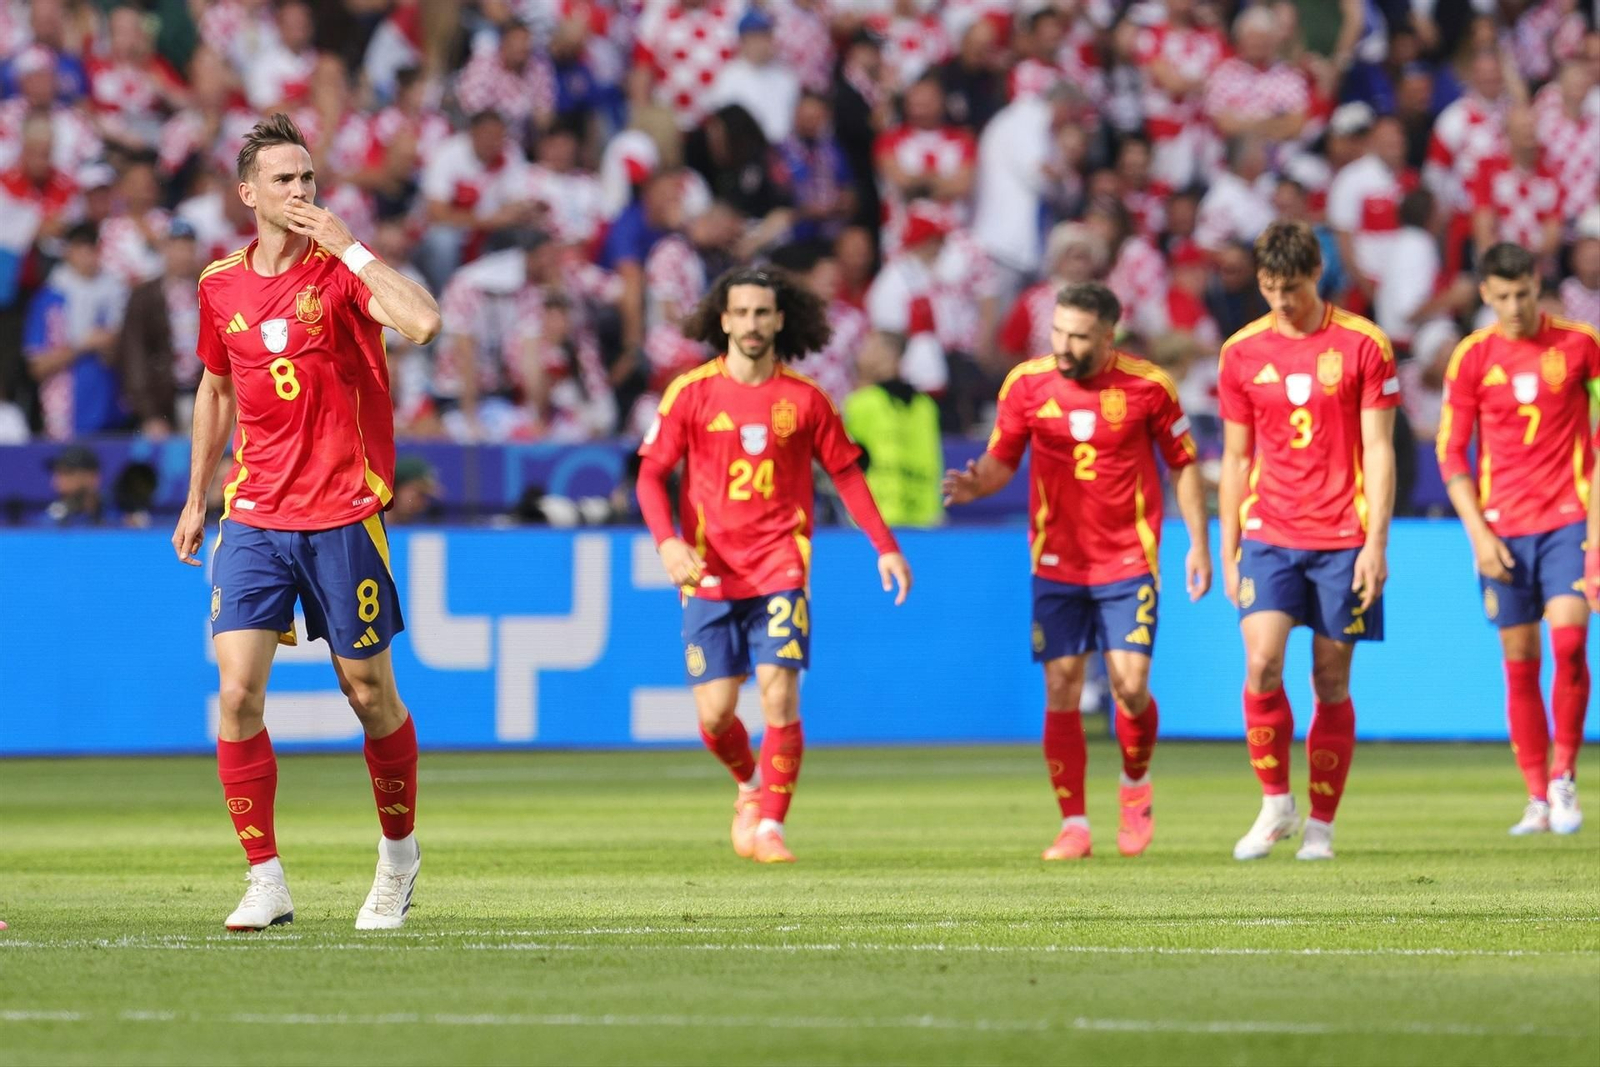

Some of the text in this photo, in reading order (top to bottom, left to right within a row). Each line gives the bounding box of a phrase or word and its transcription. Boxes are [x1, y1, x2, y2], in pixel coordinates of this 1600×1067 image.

[269, 357, 301, 401] 8
[1289, 406, 1313, 449] 3
[1518, 404, 1542, 445] 7
[728, 459, 775, 501] 24
[1072, 442, 1098, 481] 2
[356, 578, 380, 623] 8
[767, 596, 809, 637] 24
[1136, 585, 1156, 624] 2
